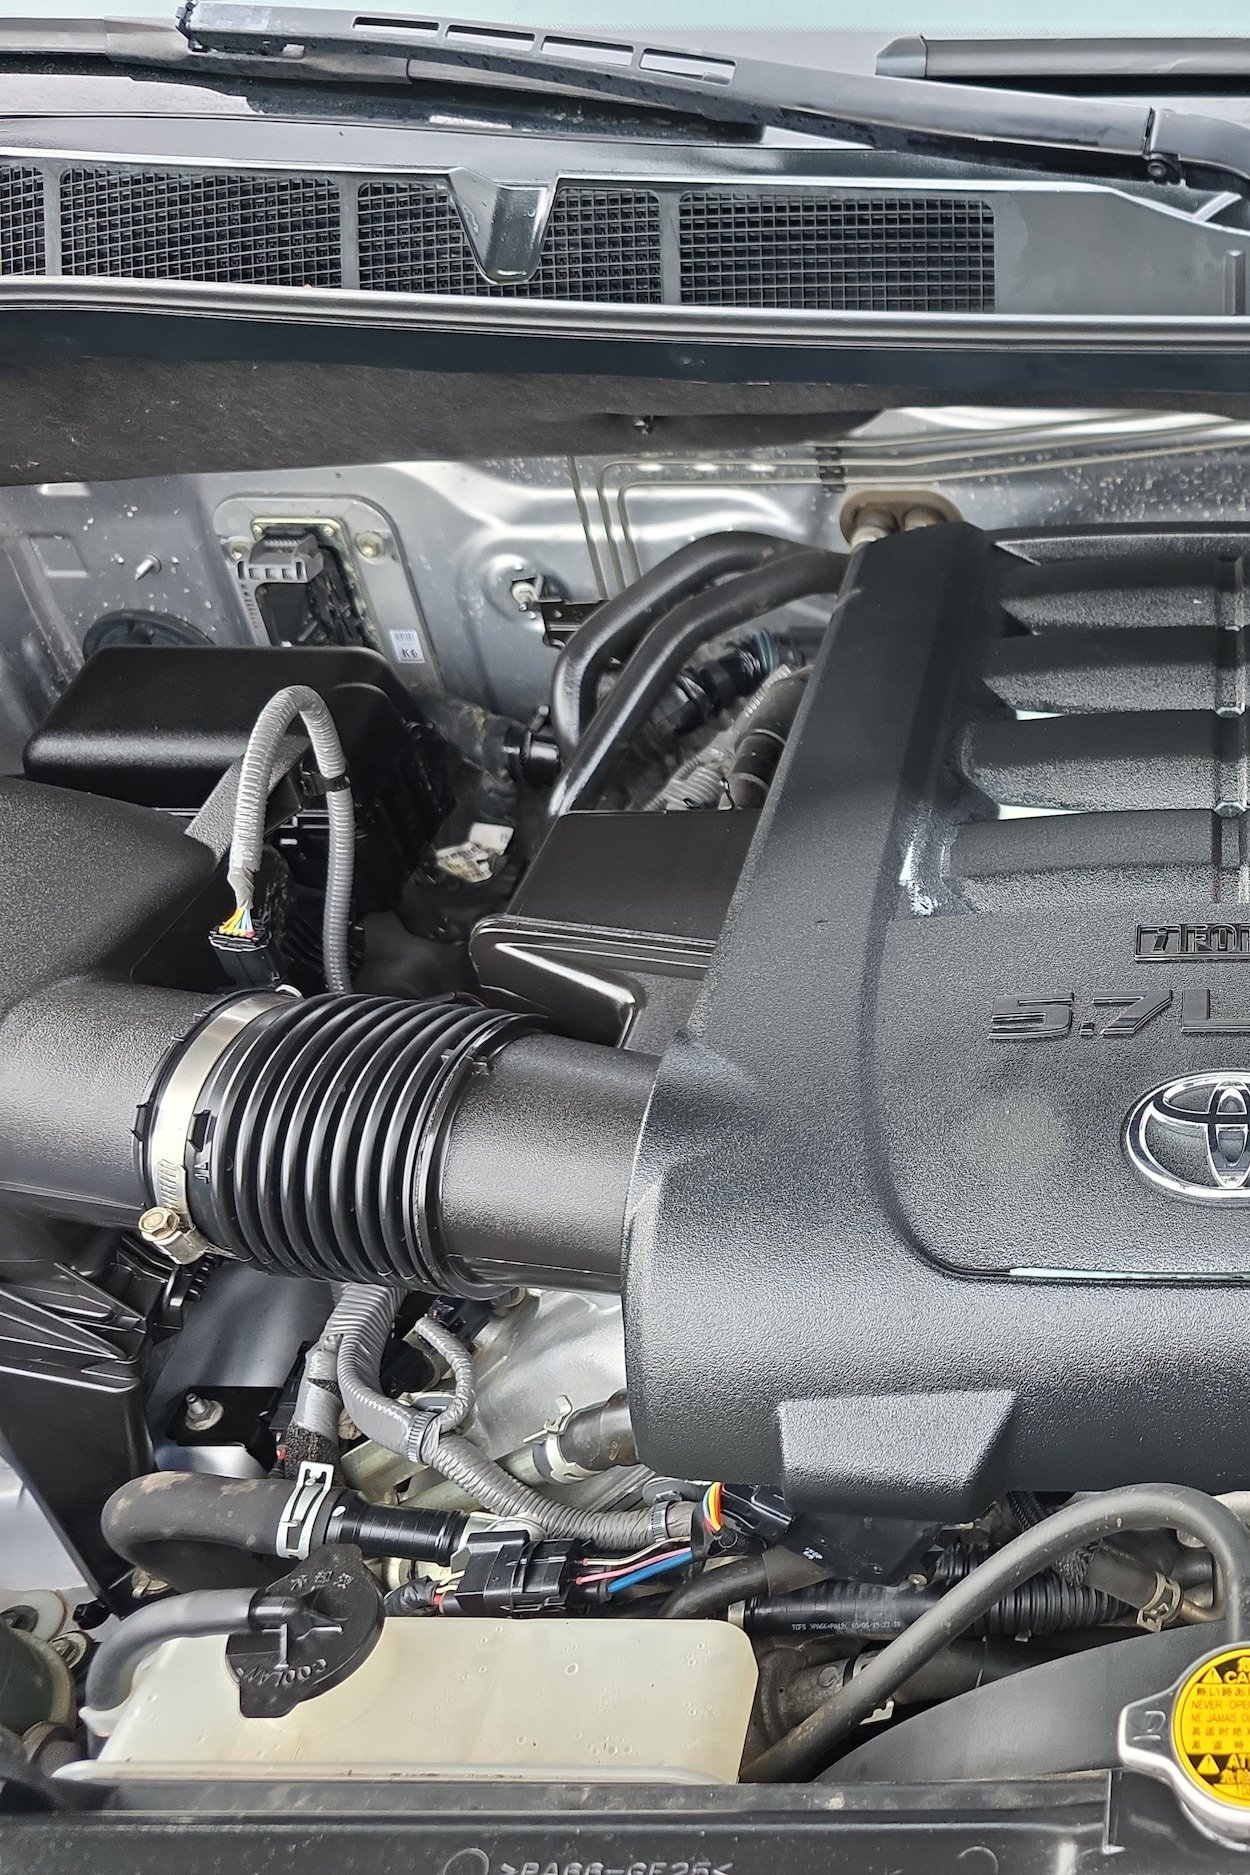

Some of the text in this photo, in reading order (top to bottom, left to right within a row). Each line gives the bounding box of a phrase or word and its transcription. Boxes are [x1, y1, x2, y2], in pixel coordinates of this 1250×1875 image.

[1192, 1700, 1222, 1709] NEVER
[1192, 1714, 1201, 1722] NE
[1206, 1714, 1236, 1722] JAMAIS
